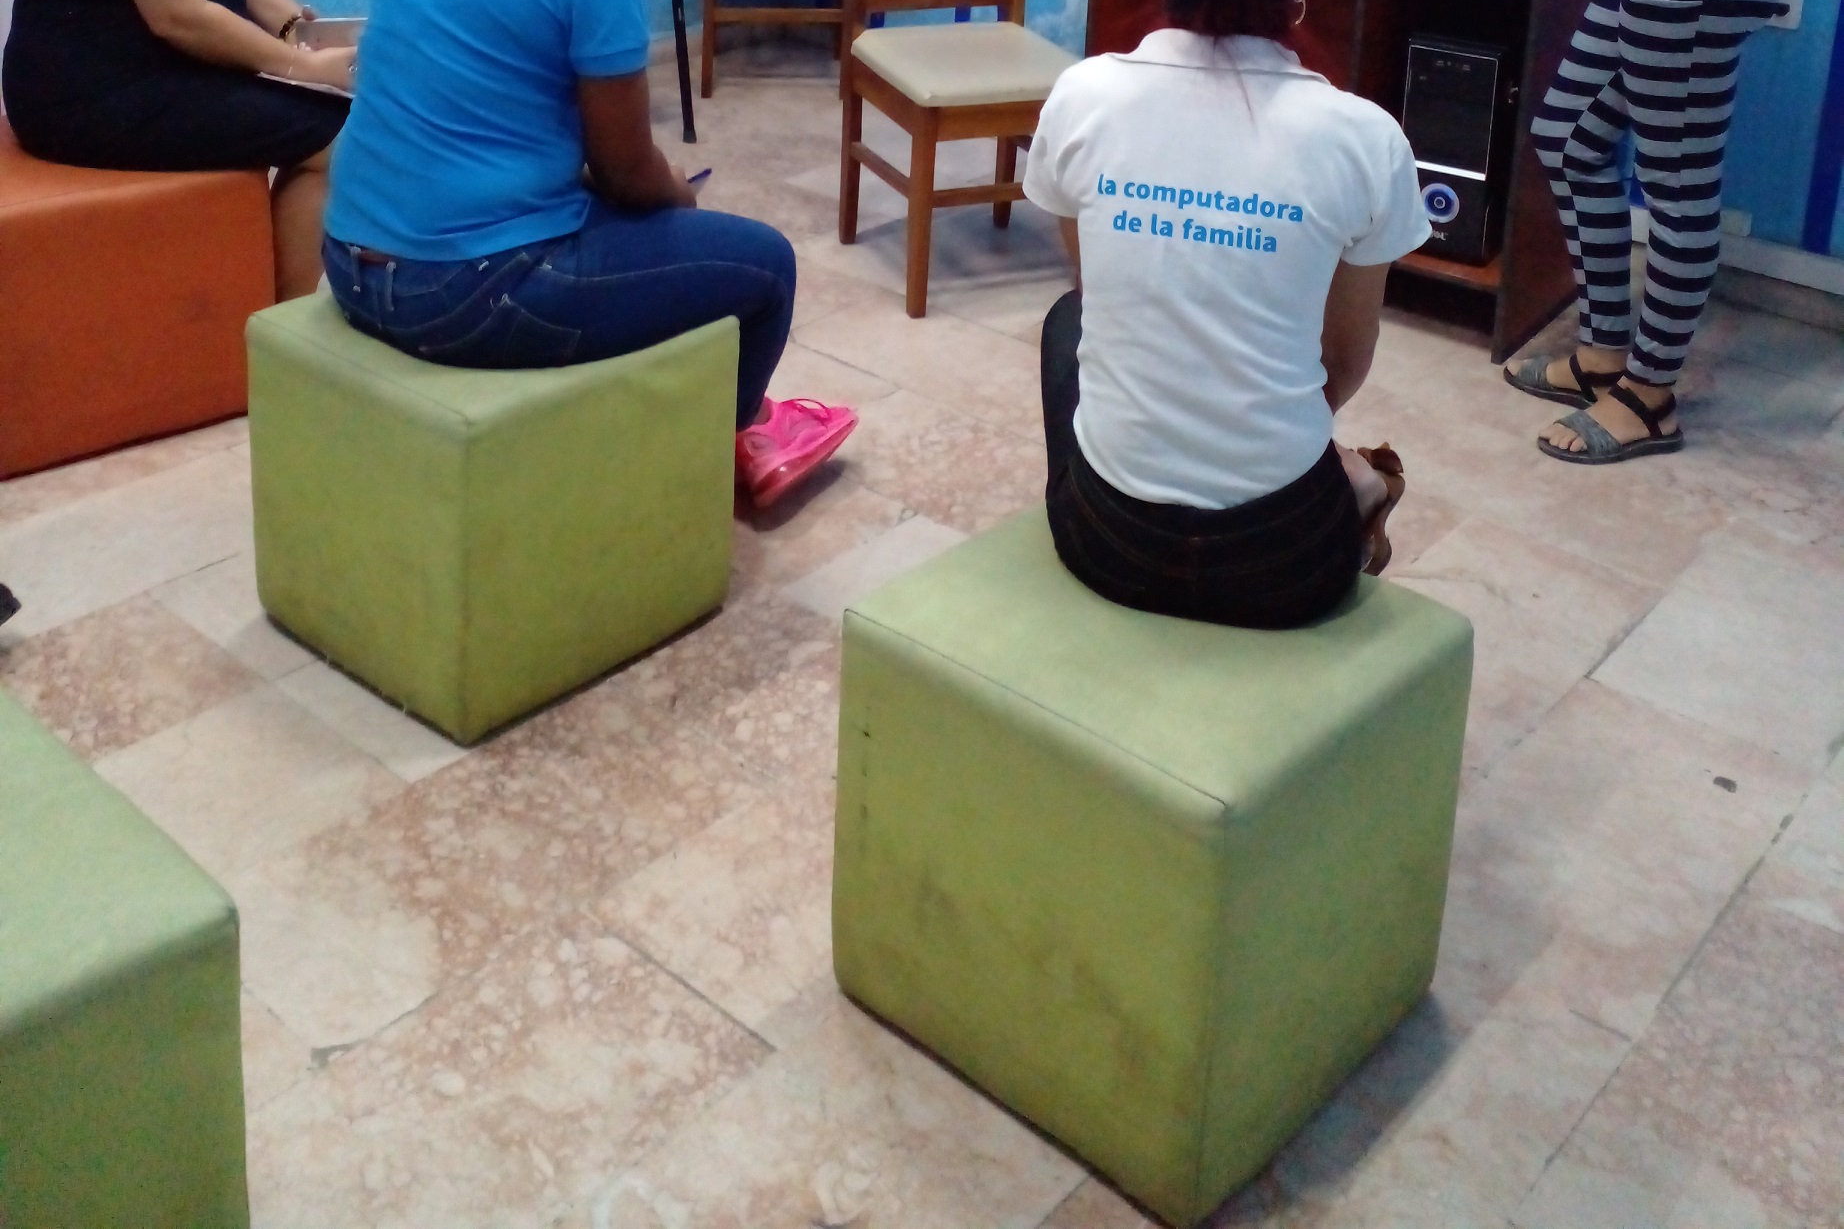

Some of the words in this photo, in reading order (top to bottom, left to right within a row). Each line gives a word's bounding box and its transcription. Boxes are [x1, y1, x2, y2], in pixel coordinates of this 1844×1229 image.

[1097, 173, 1117, 195] la
[1123, 181, 1304, 223] computadora
[1112, 210, 1142, 233] de
[1150, 213, 1173, 237] la
[1182, 218, 1277, 252] familia
